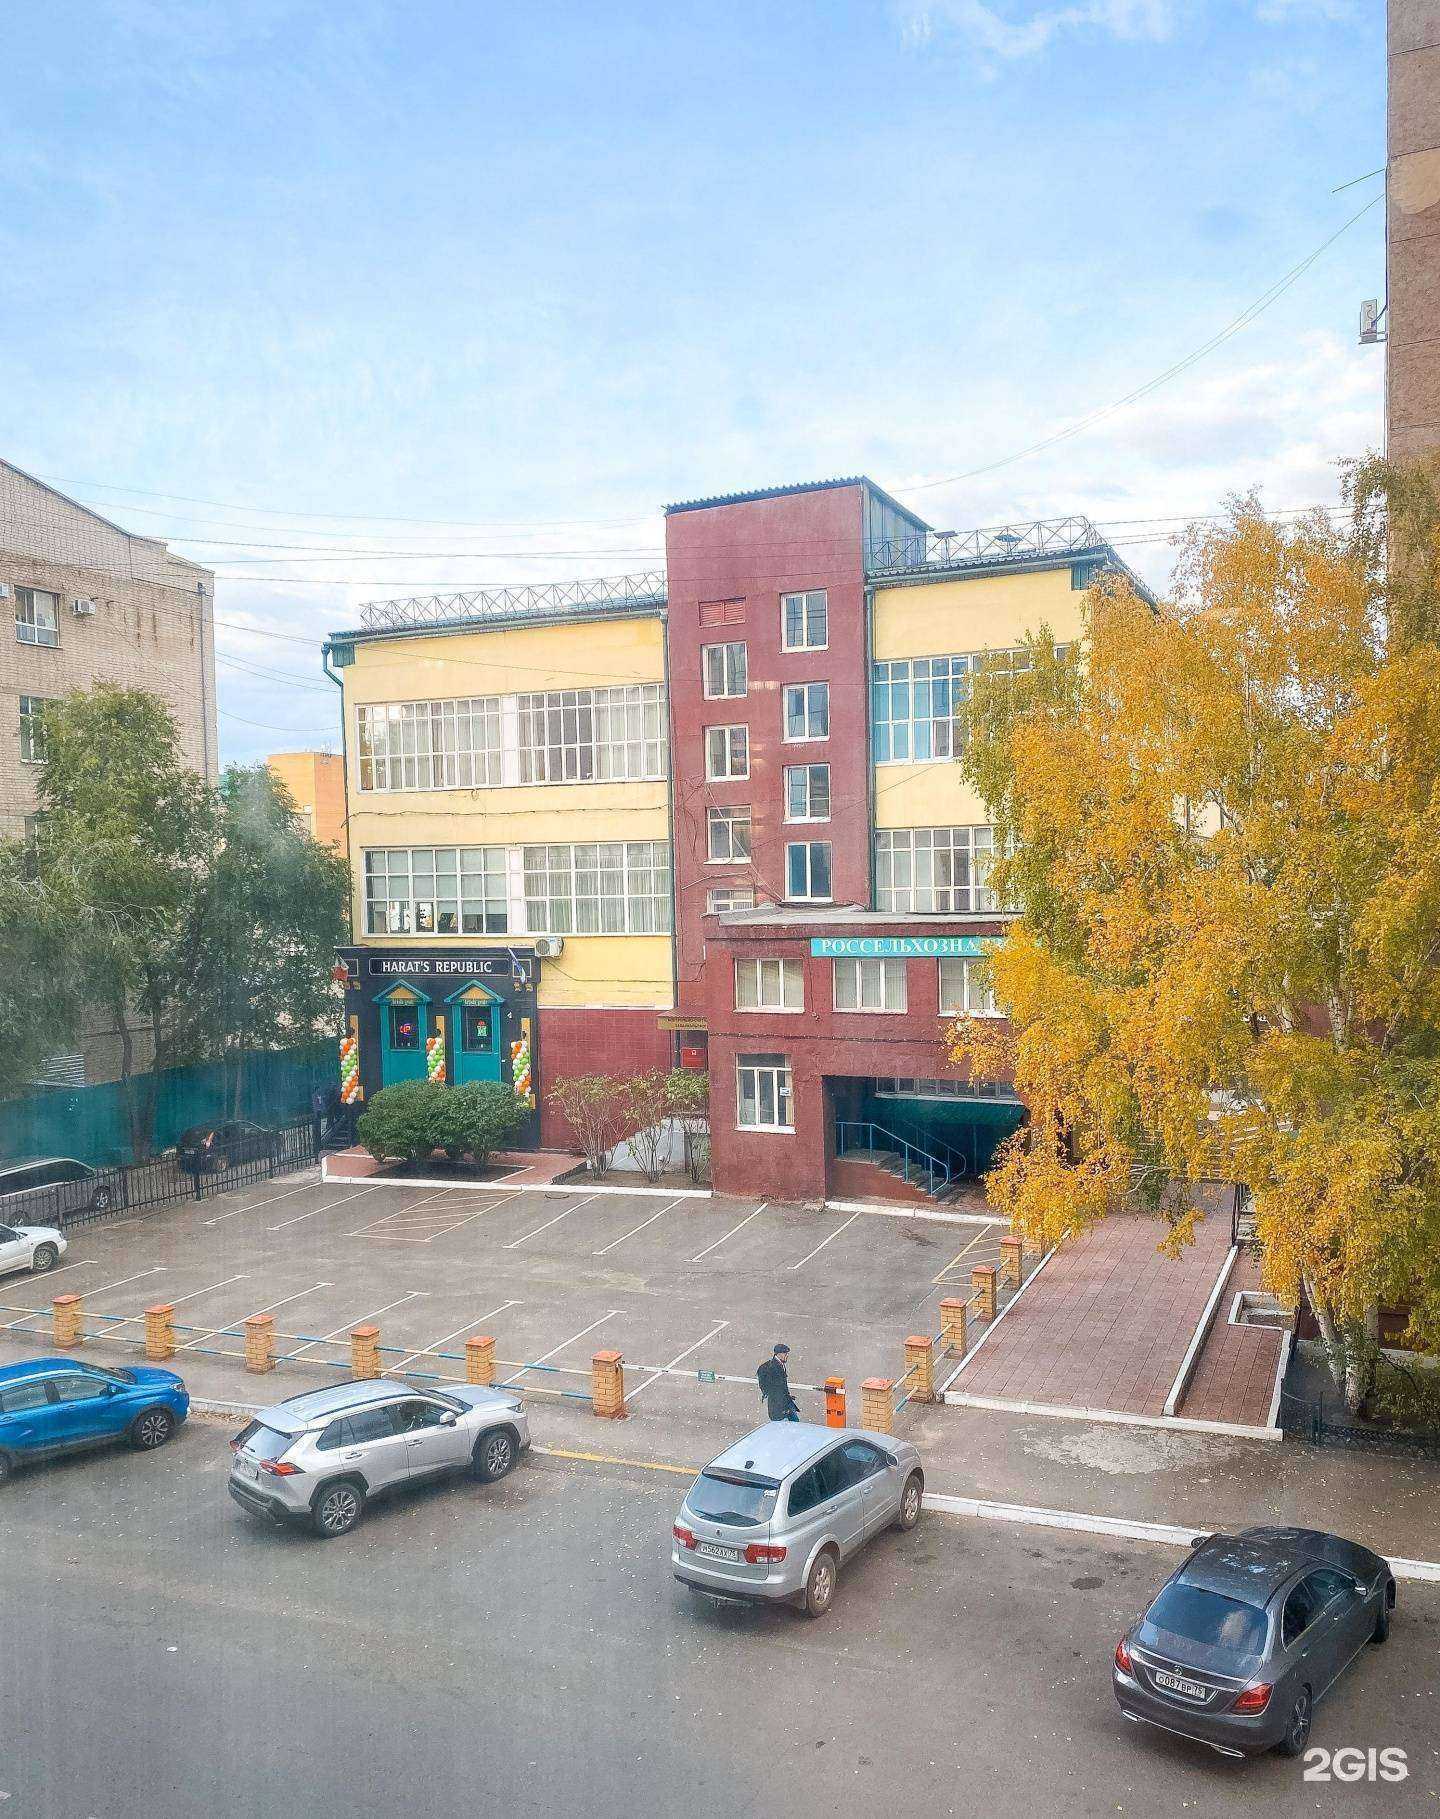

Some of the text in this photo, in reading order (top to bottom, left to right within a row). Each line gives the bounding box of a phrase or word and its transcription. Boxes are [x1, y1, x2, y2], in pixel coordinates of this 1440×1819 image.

[821, 938, 1006, 954] РОССЕЛЬХОЗНА
[382, 961, 492, 973] HARAT'S REPUBLIC
